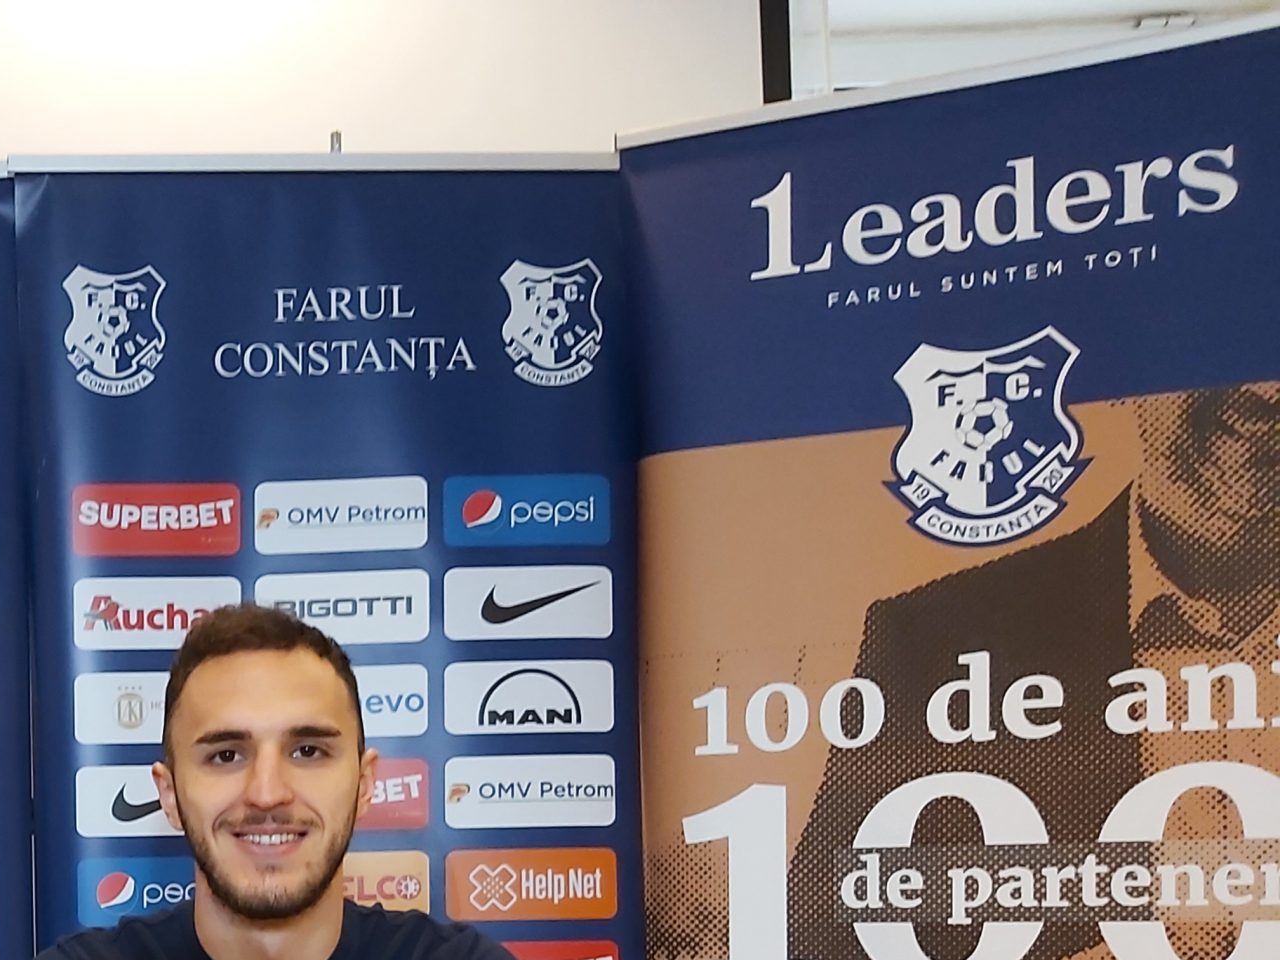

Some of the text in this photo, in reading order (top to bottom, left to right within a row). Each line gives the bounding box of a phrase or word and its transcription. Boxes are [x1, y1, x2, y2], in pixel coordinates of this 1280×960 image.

[827, 280, 921, 310] FARUL
[941, 259, 1064, 293] SUNTEM
[274, 285, 416, 323] FARUL
[214, 337, 477, 380] CONSTANȚA
[78, 499, 234, 531] SUPERBET
[287, 504, 426, 526] OMV Petrom
[510, 496, 594, 528] pepsi
[83, 595, 214, 632] Auch
[365, 693, 424, 714] evo
[487, 708, 573, 726] MAN
[691, 676, 886, 756] 100
[926, 650, 1065, 744] de
[479, 781, 614, 799] OMV Petrom
[521, 867, 602, 904] Help Net
[840, 853, 1280, 926] de partener
